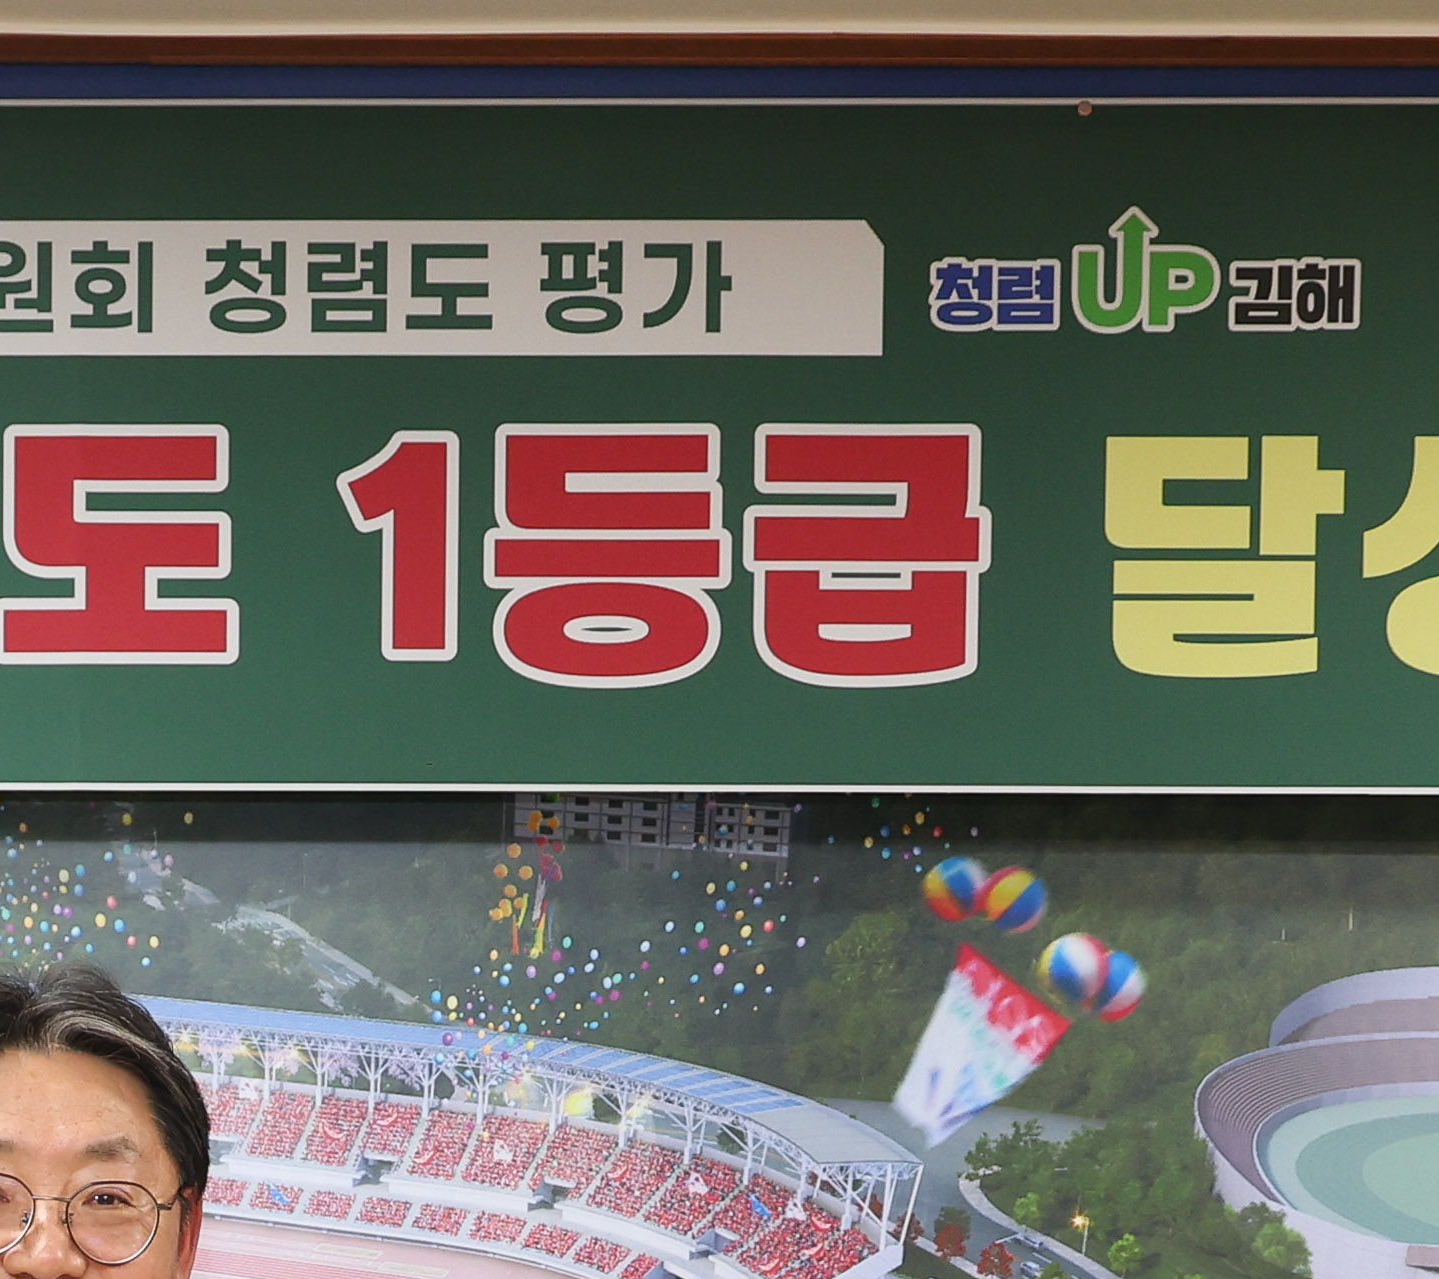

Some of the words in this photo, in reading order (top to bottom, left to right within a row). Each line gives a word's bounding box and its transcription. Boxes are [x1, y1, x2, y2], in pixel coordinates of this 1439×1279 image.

[204, 240, 495, 334] 청렴도
[539, 240, 734, 334] 평가
[930, 257, 1060, 331] 청렴
[1072, 205, 1221, 334] UP
[1228, 257, 1361, 331] 김해
[336, 424, 991, 688] 1등급
